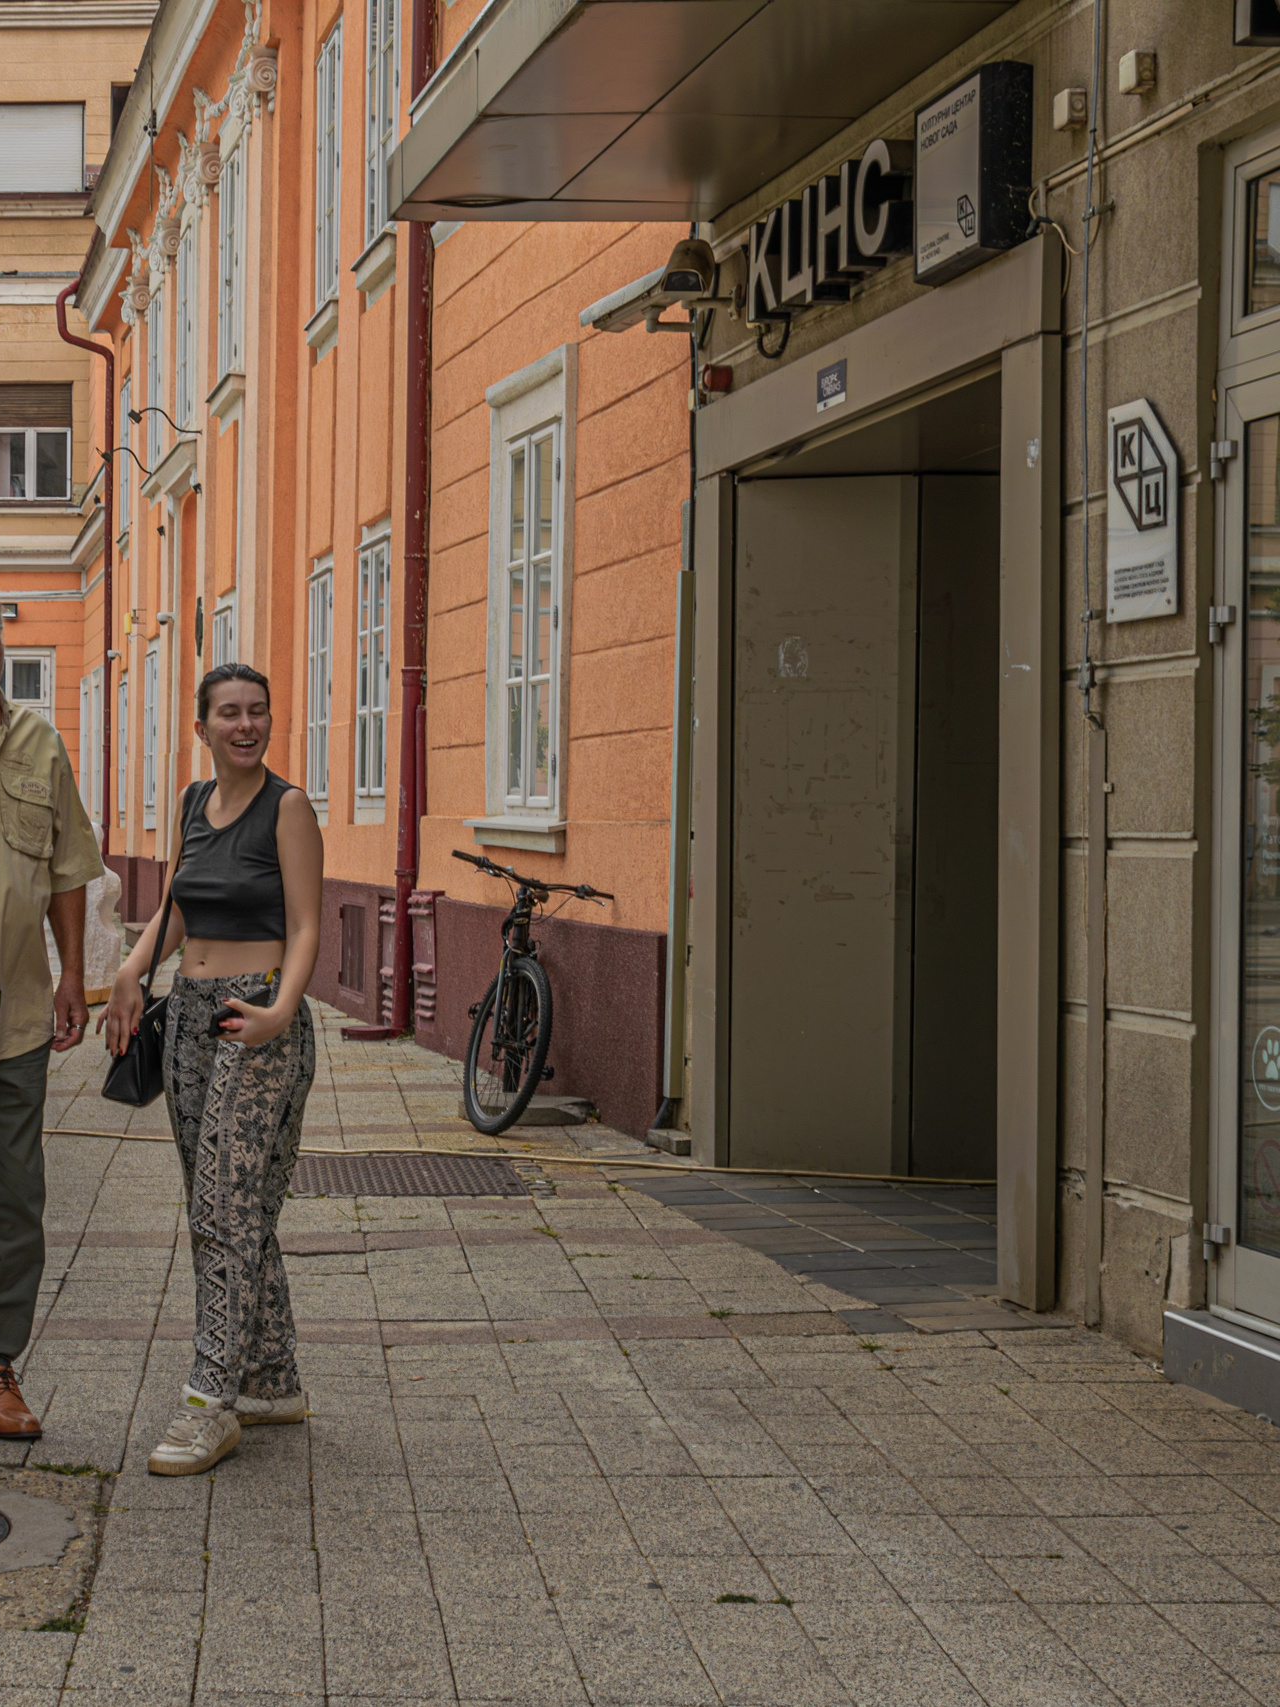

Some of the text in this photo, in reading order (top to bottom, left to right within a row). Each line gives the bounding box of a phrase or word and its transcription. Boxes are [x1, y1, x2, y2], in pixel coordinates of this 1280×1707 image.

[920, 88, 976, 135] КУЛТУРНИ ЦЕНТАР
[920, 119, 958, 152] НОВОГ САДА
[748, 138, 891, 322] КЦНС
